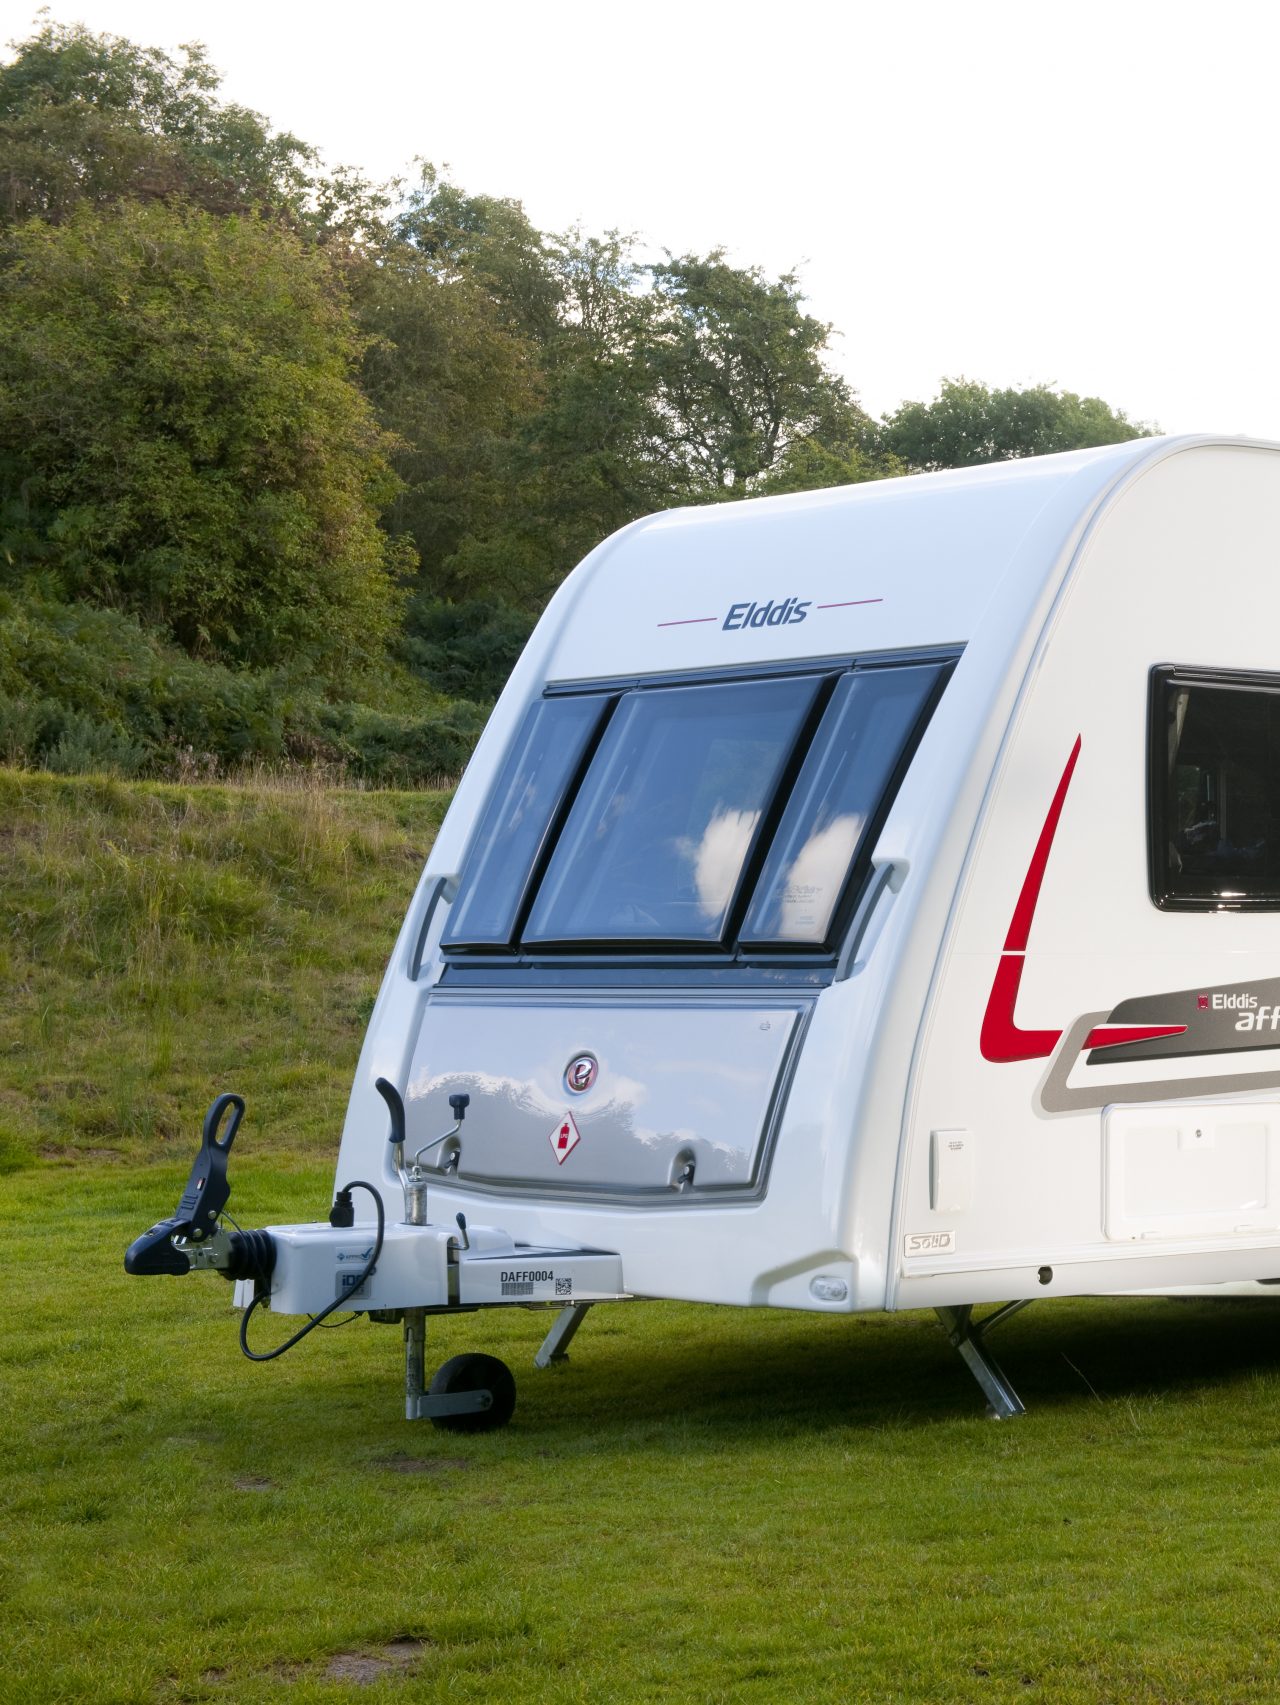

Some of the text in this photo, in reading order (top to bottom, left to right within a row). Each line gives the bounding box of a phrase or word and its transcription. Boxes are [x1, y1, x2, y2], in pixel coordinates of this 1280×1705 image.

[722, 597, 812, 631] Elddis
[1212, 993, 1258, 1010] Elddis
[500, 1270, 554, 1283] DAFF0004
